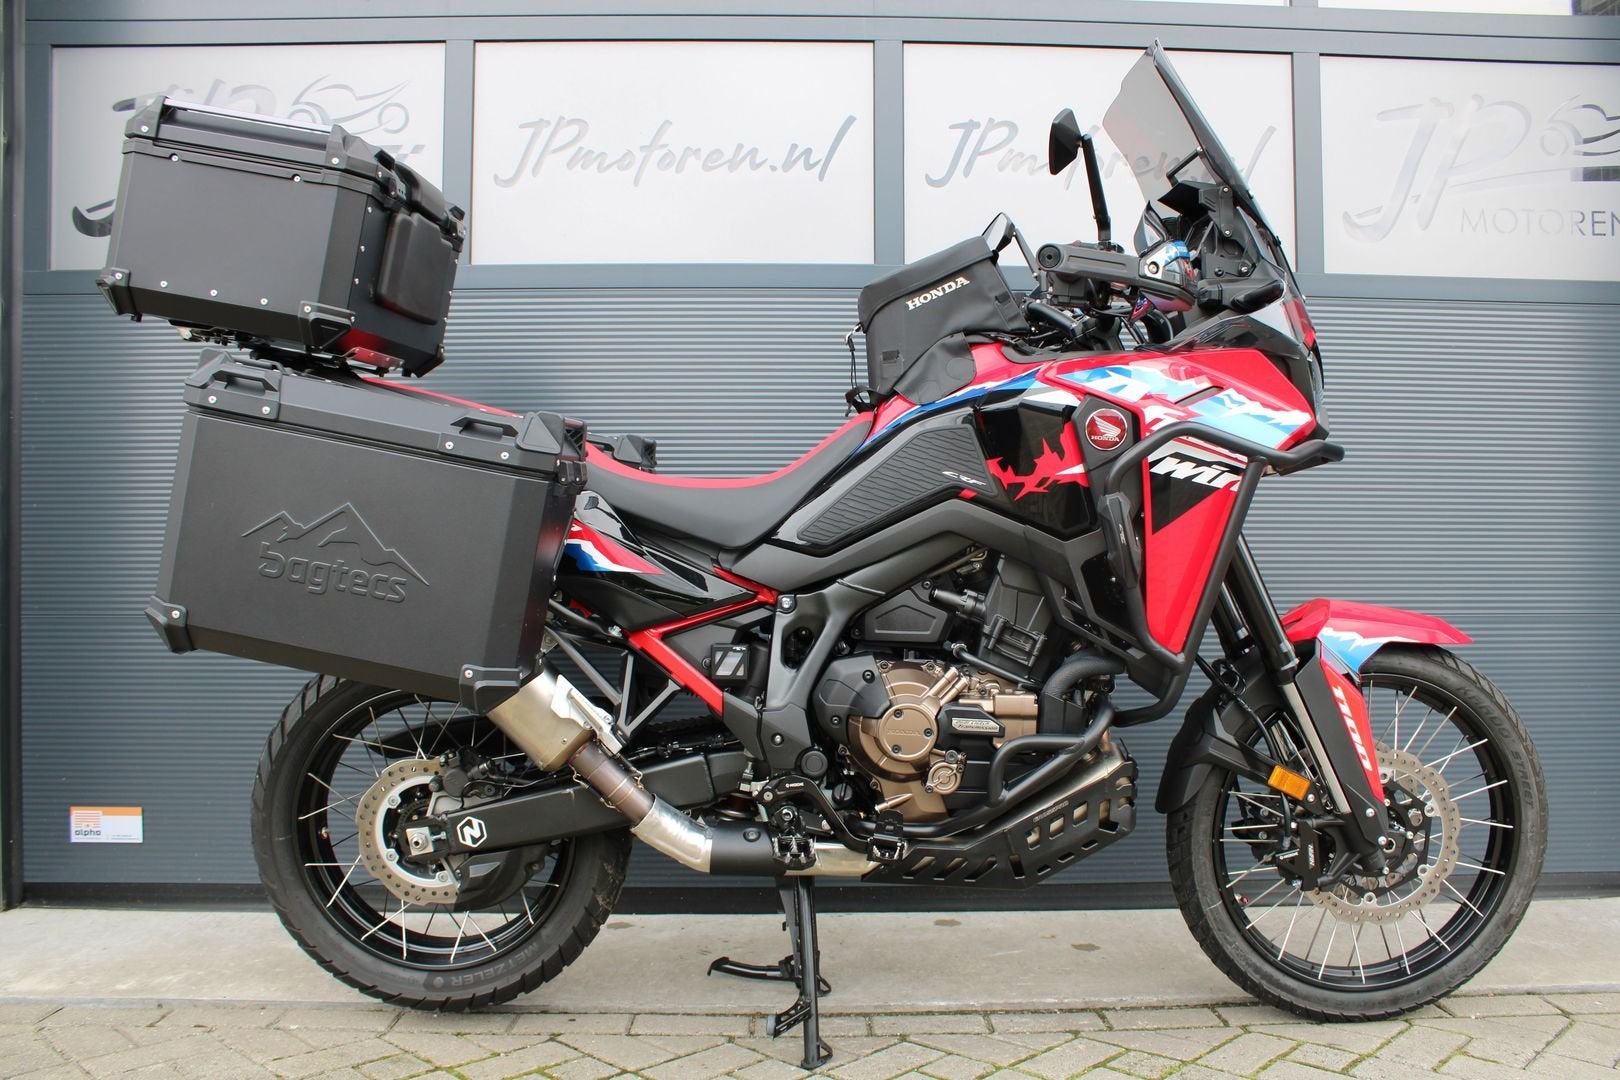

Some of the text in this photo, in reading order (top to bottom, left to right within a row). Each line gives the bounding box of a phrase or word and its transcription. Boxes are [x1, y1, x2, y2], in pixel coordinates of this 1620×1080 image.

[493, 115, 858, 188] JPmotoren.nl
[905, 276, 970, 311] HONDA
[1510, 750, 1535, 809] STREET
[74, 829, 102, 837] alpha
[451, 942, 539, 987] METZELER
